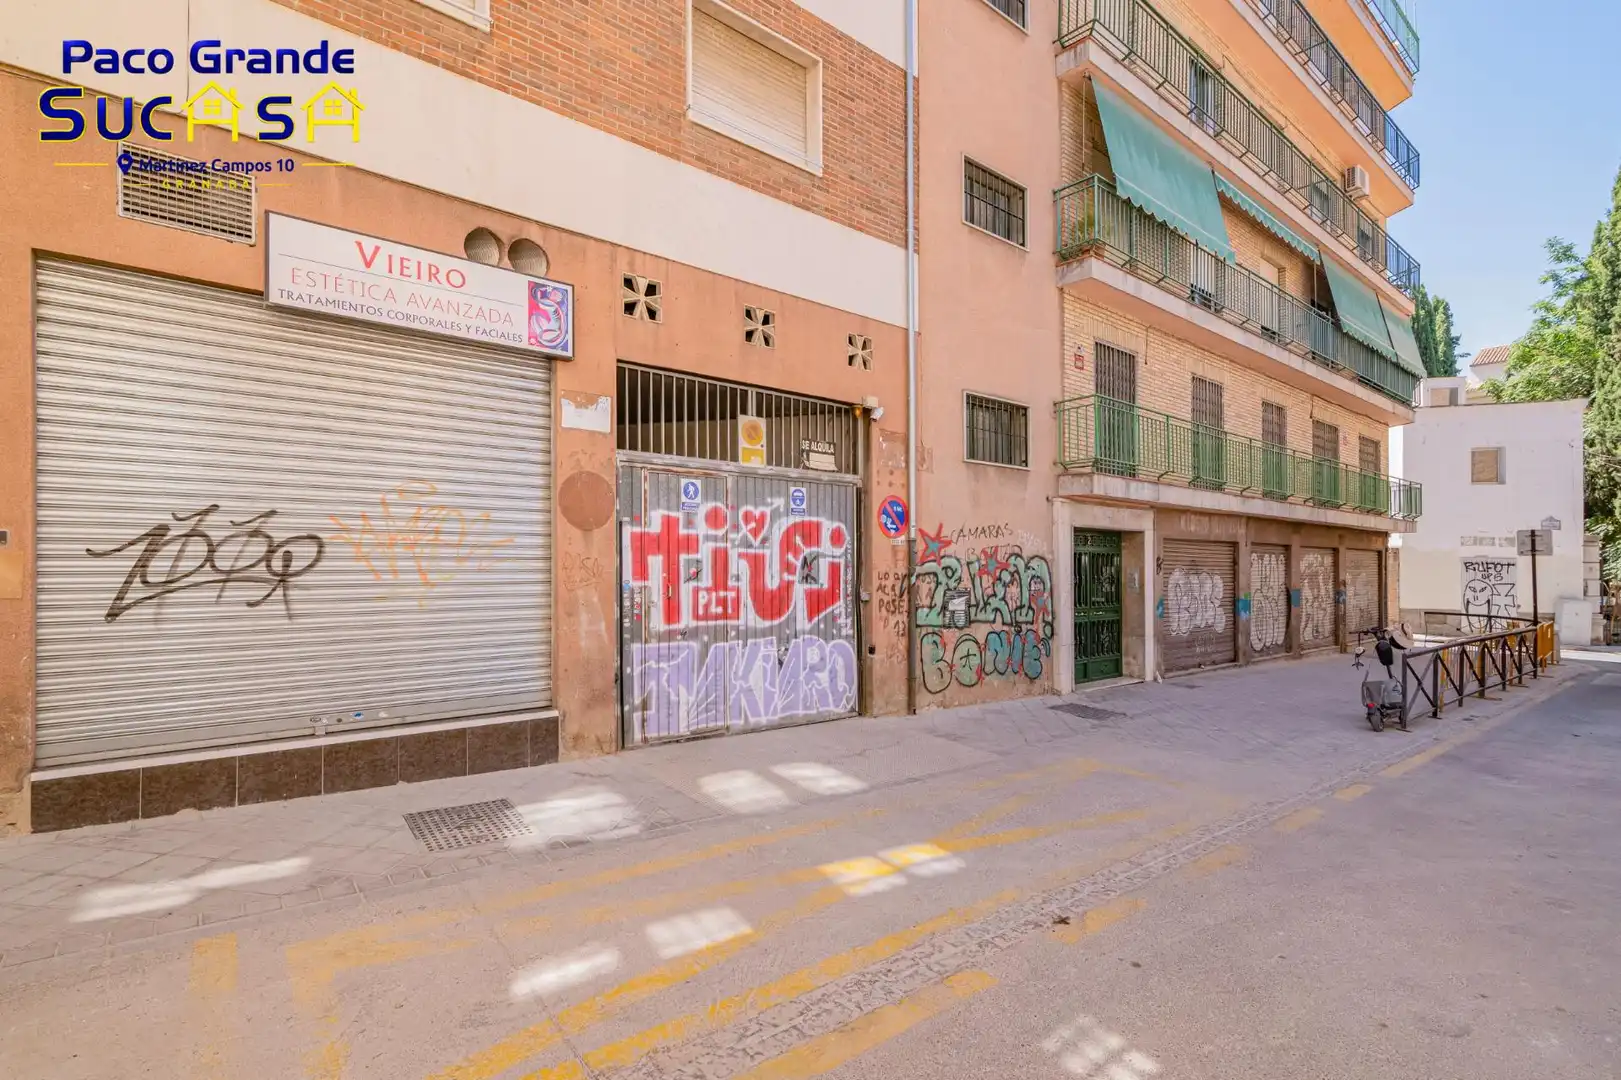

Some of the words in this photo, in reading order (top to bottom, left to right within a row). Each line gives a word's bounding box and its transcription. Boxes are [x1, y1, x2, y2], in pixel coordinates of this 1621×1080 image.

[278, 288, 384, 318] TRATAMIENTOS
[386, 309, 463, 332] CORPORALES
[465, 323, 473, 335] Y
[475, 326, 524, 343] FACIALES
[291, 266, 398, 304] ESTÉTICA
[406, 291, 514, 328] AVANZADA
[800, 439, 810, 450] SE
[810, 440, 835, 454] ALQUILA
